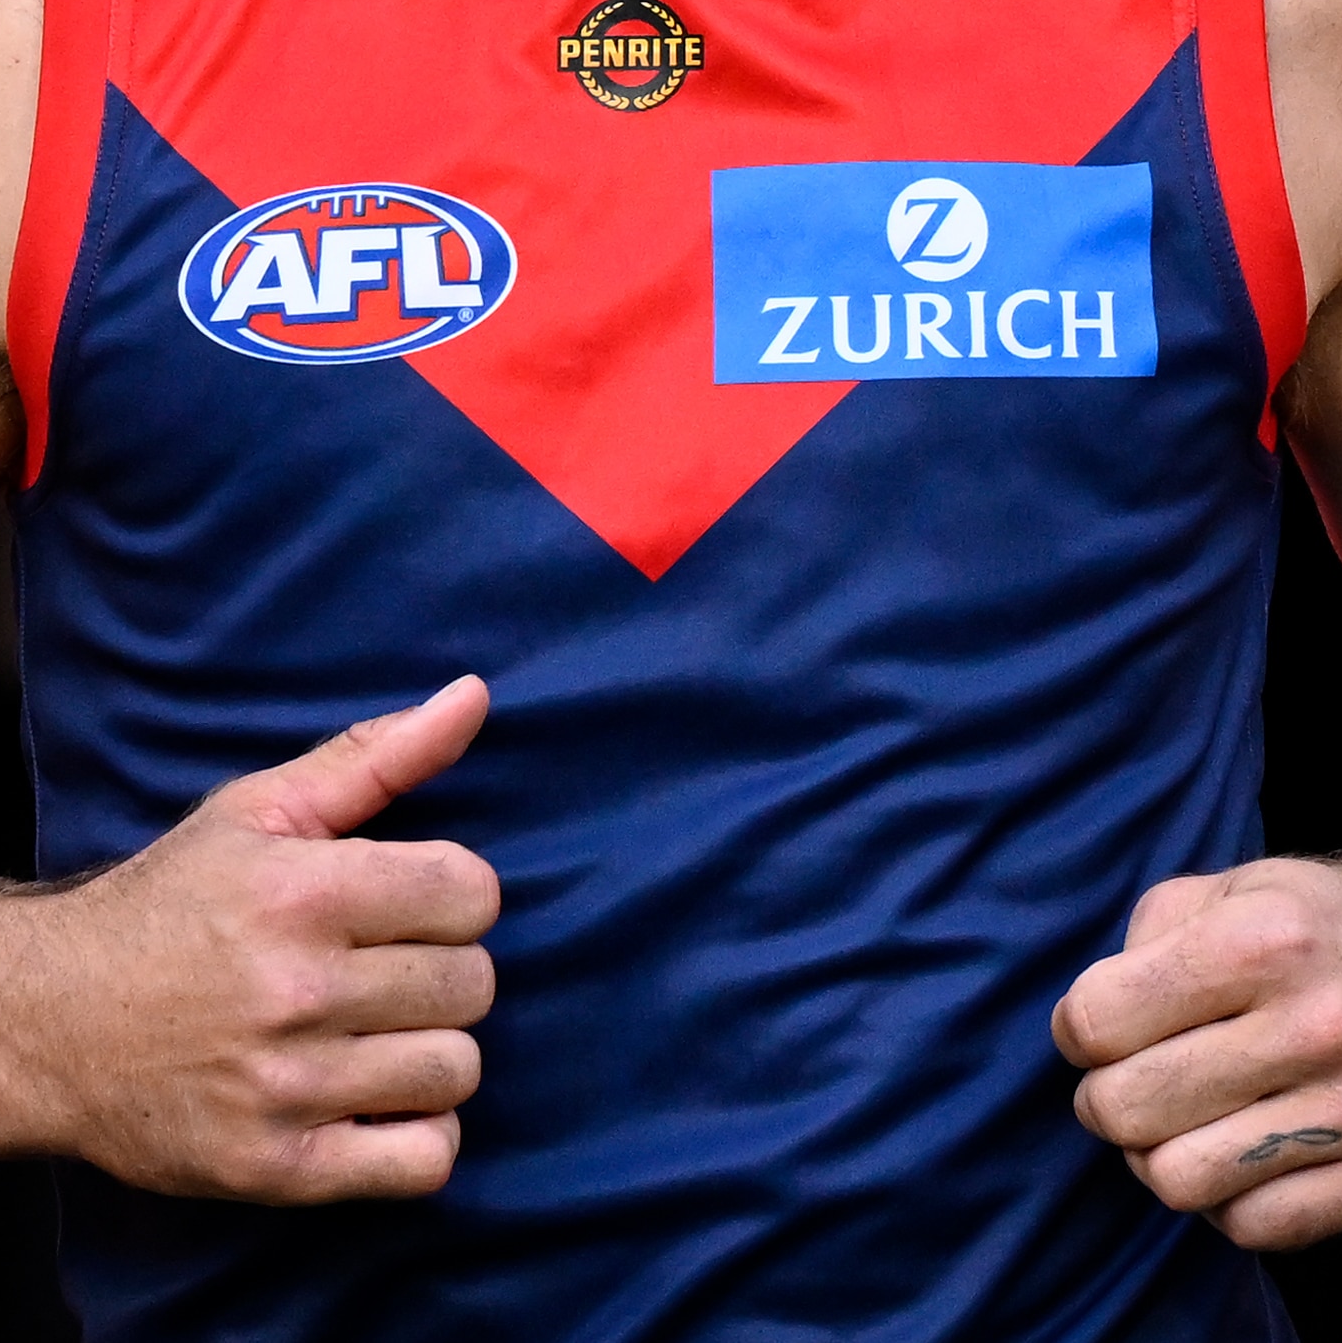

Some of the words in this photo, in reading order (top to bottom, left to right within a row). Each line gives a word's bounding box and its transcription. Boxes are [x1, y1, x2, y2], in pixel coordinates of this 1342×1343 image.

[560, 38, 702, 68] PENRITE
[901, 198, 973, 265] Z
[210, 225, 484, 322] AFL
[758, 289, 1118, 364] ZURICH
